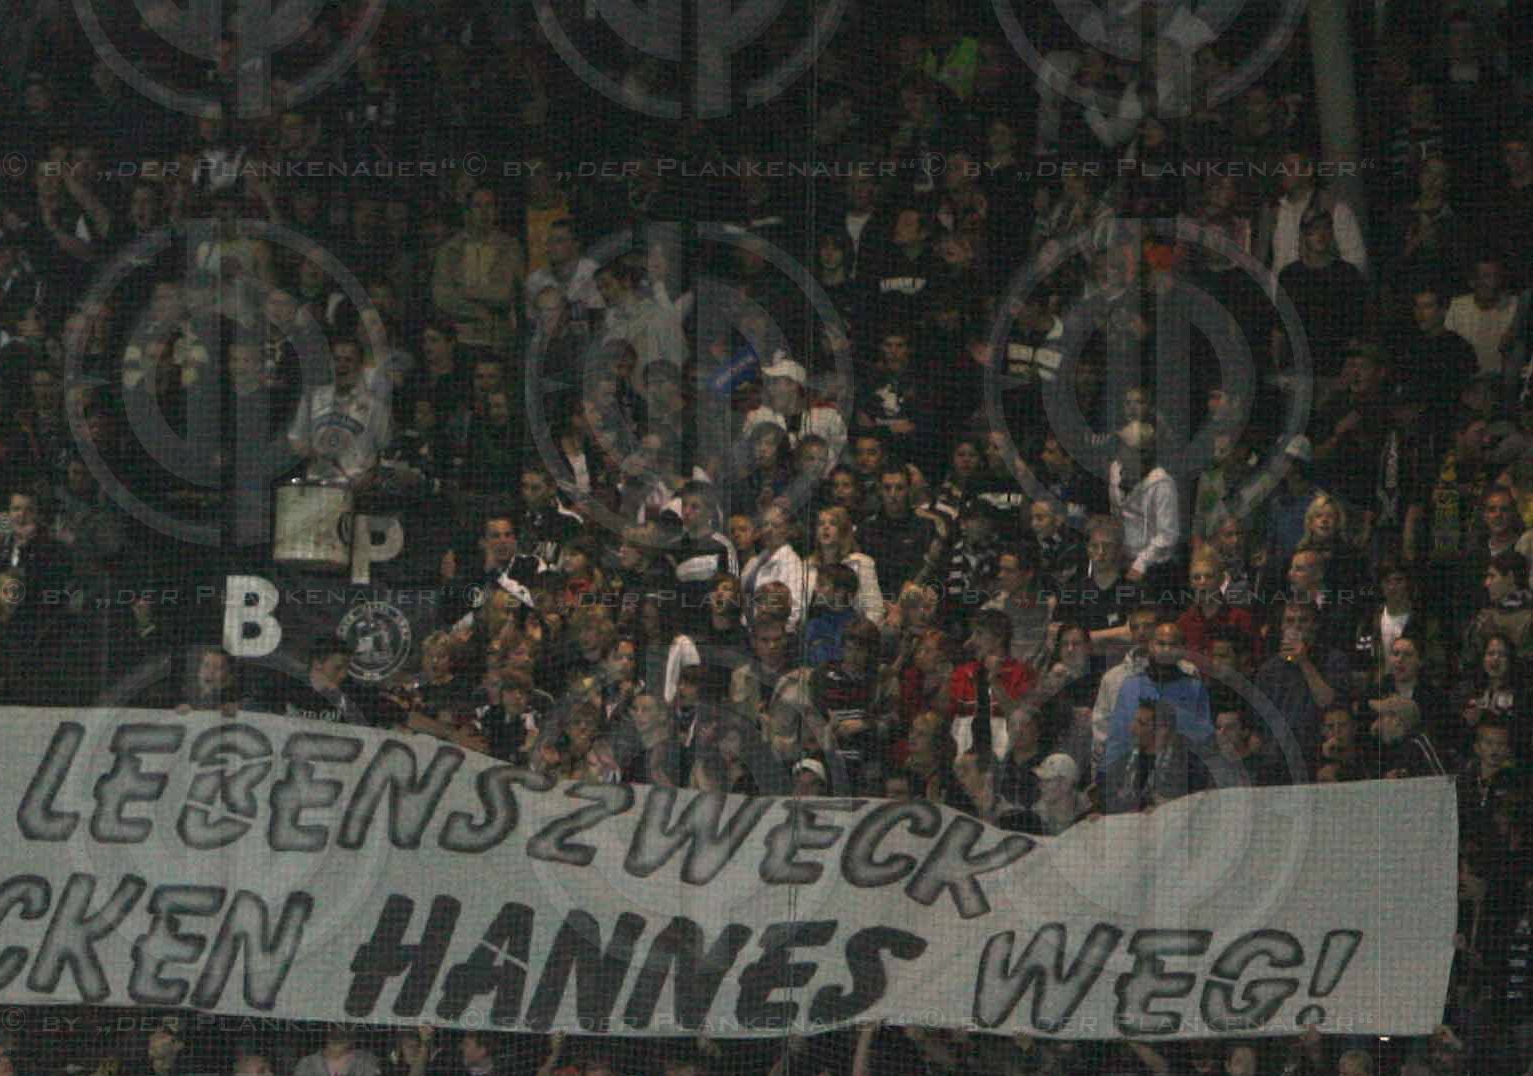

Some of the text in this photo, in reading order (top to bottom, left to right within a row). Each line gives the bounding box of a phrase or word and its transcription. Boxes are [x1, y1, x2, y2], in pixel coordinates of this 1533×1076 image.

[352, 513, 404, 584] P
[223, 575, 282, 657] B
[17, 721, 1037, 919] LEBENSZWECK
[344, 893, 927, 1032] HANNES
[974, 922, 1364, 1037] WEG!
